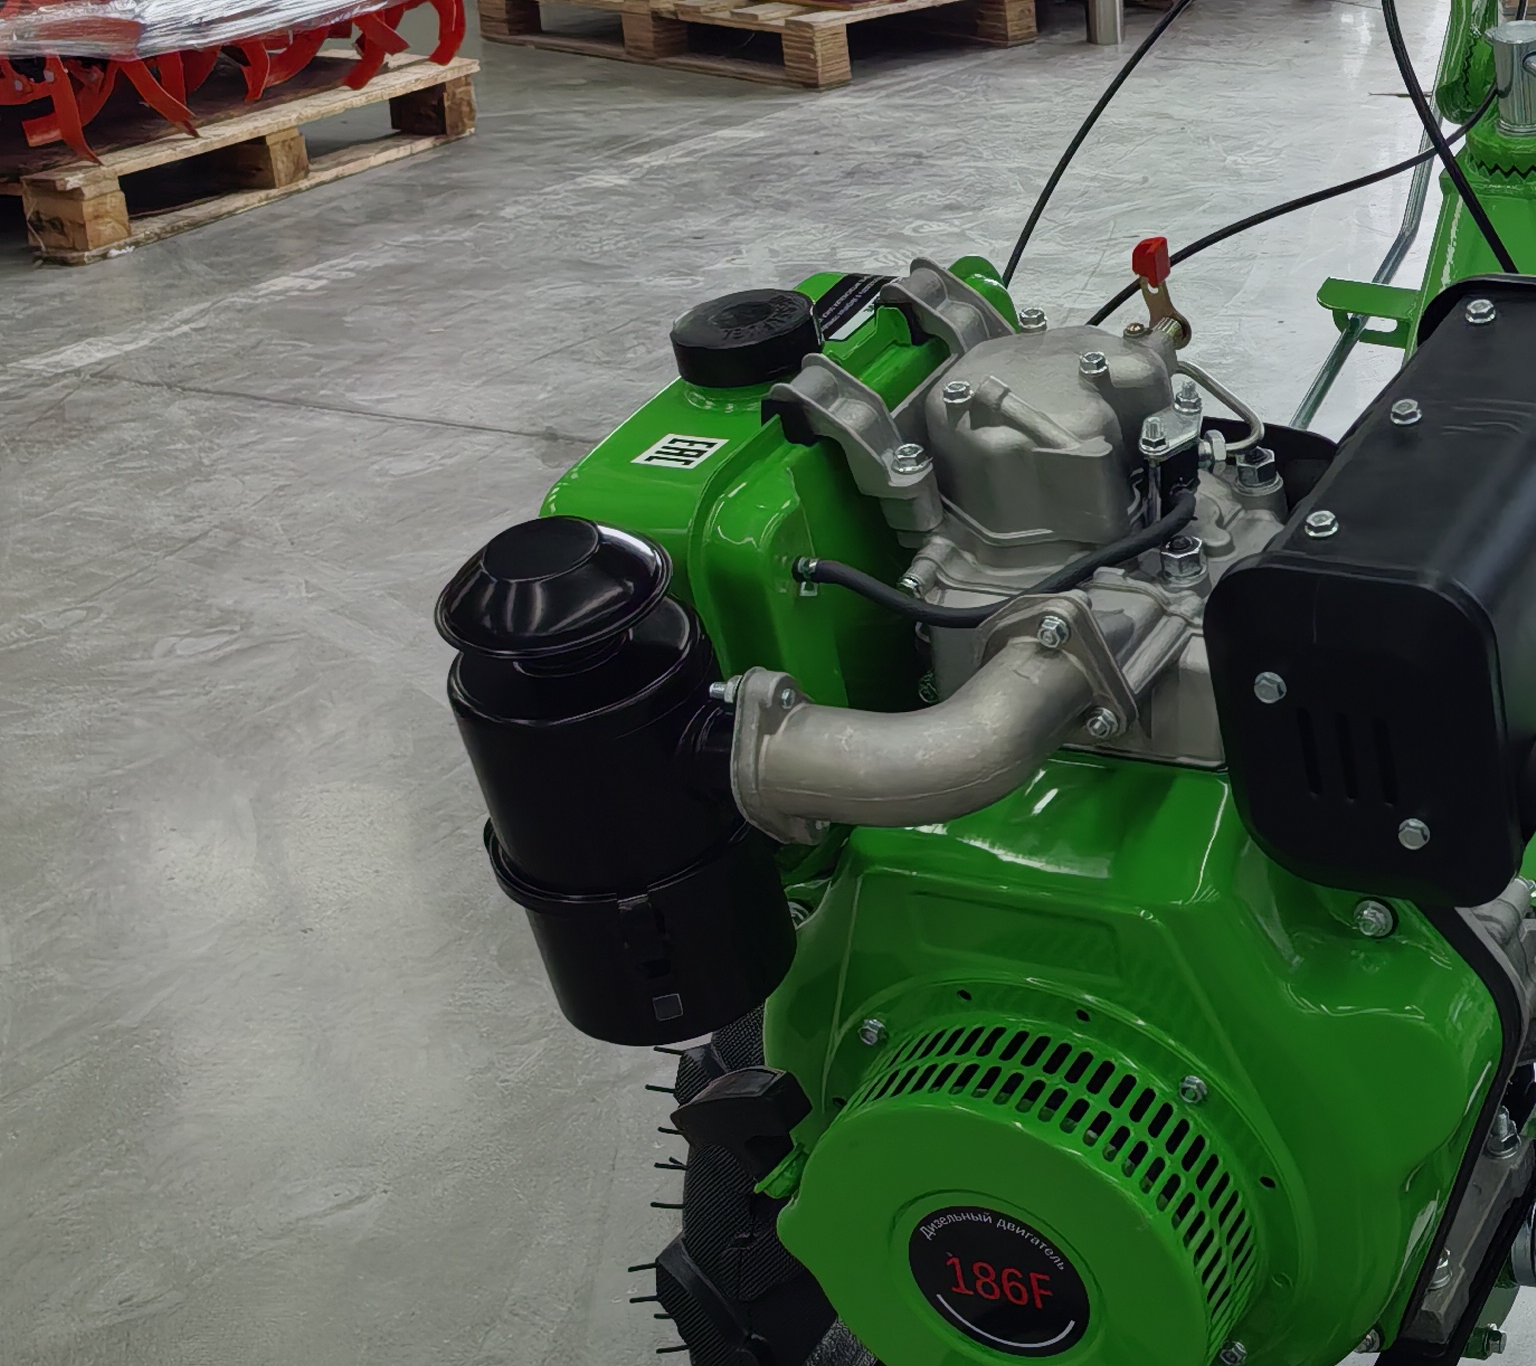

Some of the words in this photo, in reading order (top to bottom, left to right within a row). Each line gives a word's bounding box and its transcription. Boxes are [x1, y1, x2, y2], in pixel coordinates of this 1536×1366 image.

[919, 1212, 993, 1241] Дизельный
[996, 1218, 1065, 1271] двигатель
[946, 1255, 1053, 1310] 186F
